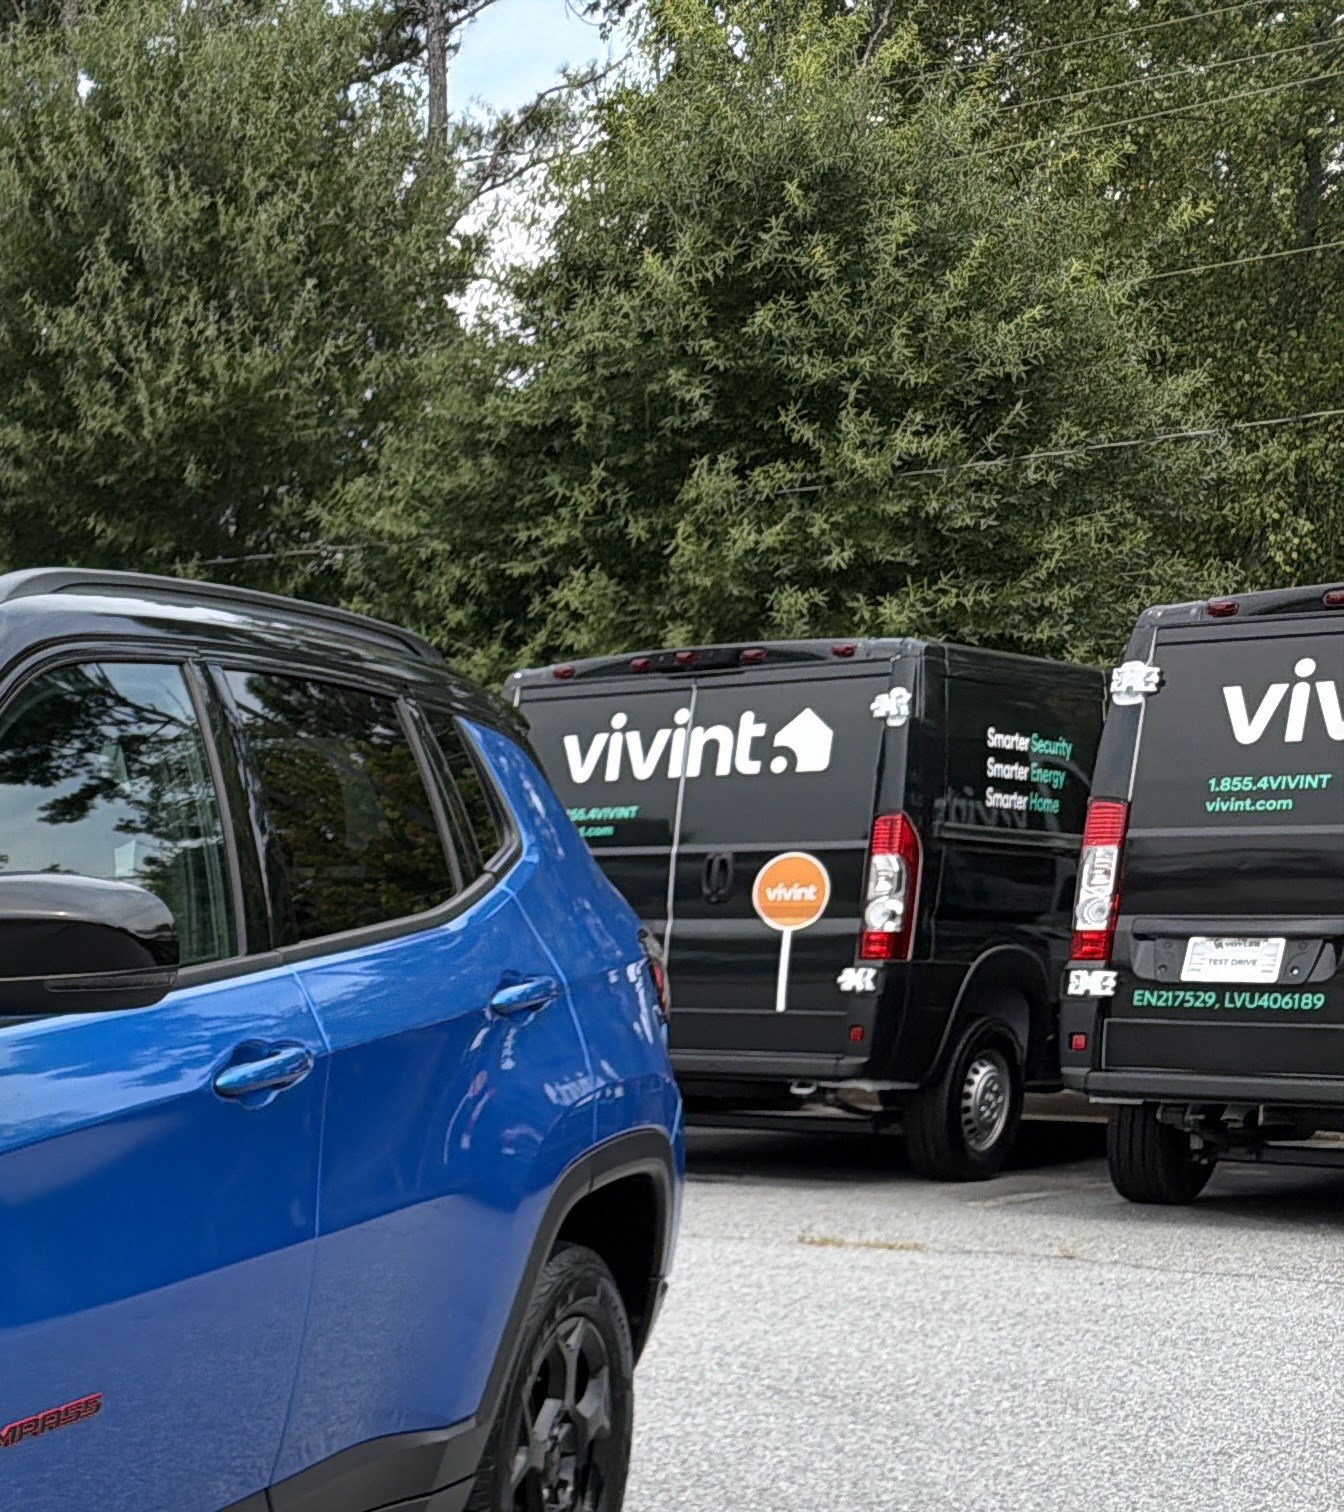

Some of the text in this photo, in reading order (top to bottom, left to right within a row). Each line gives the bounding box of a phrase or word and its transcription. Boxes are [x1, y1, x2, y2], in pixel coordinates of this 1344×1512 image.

[986, 727, 1073, 761] Smarter Security
[986, 757, 1066, 789] Smarter Energy
[1208, 774, 1332, 793] 1.855.4VIVINT
[985, 787, 1060, 814] Smarter Home
[1205, 797, 1293, 812] vivint.com
[765, 883, 818, 901] vivint
[1209, 958, 1230, 966] TEST
[1132, 989, 1325, 1010] EN217529, LVU406189
